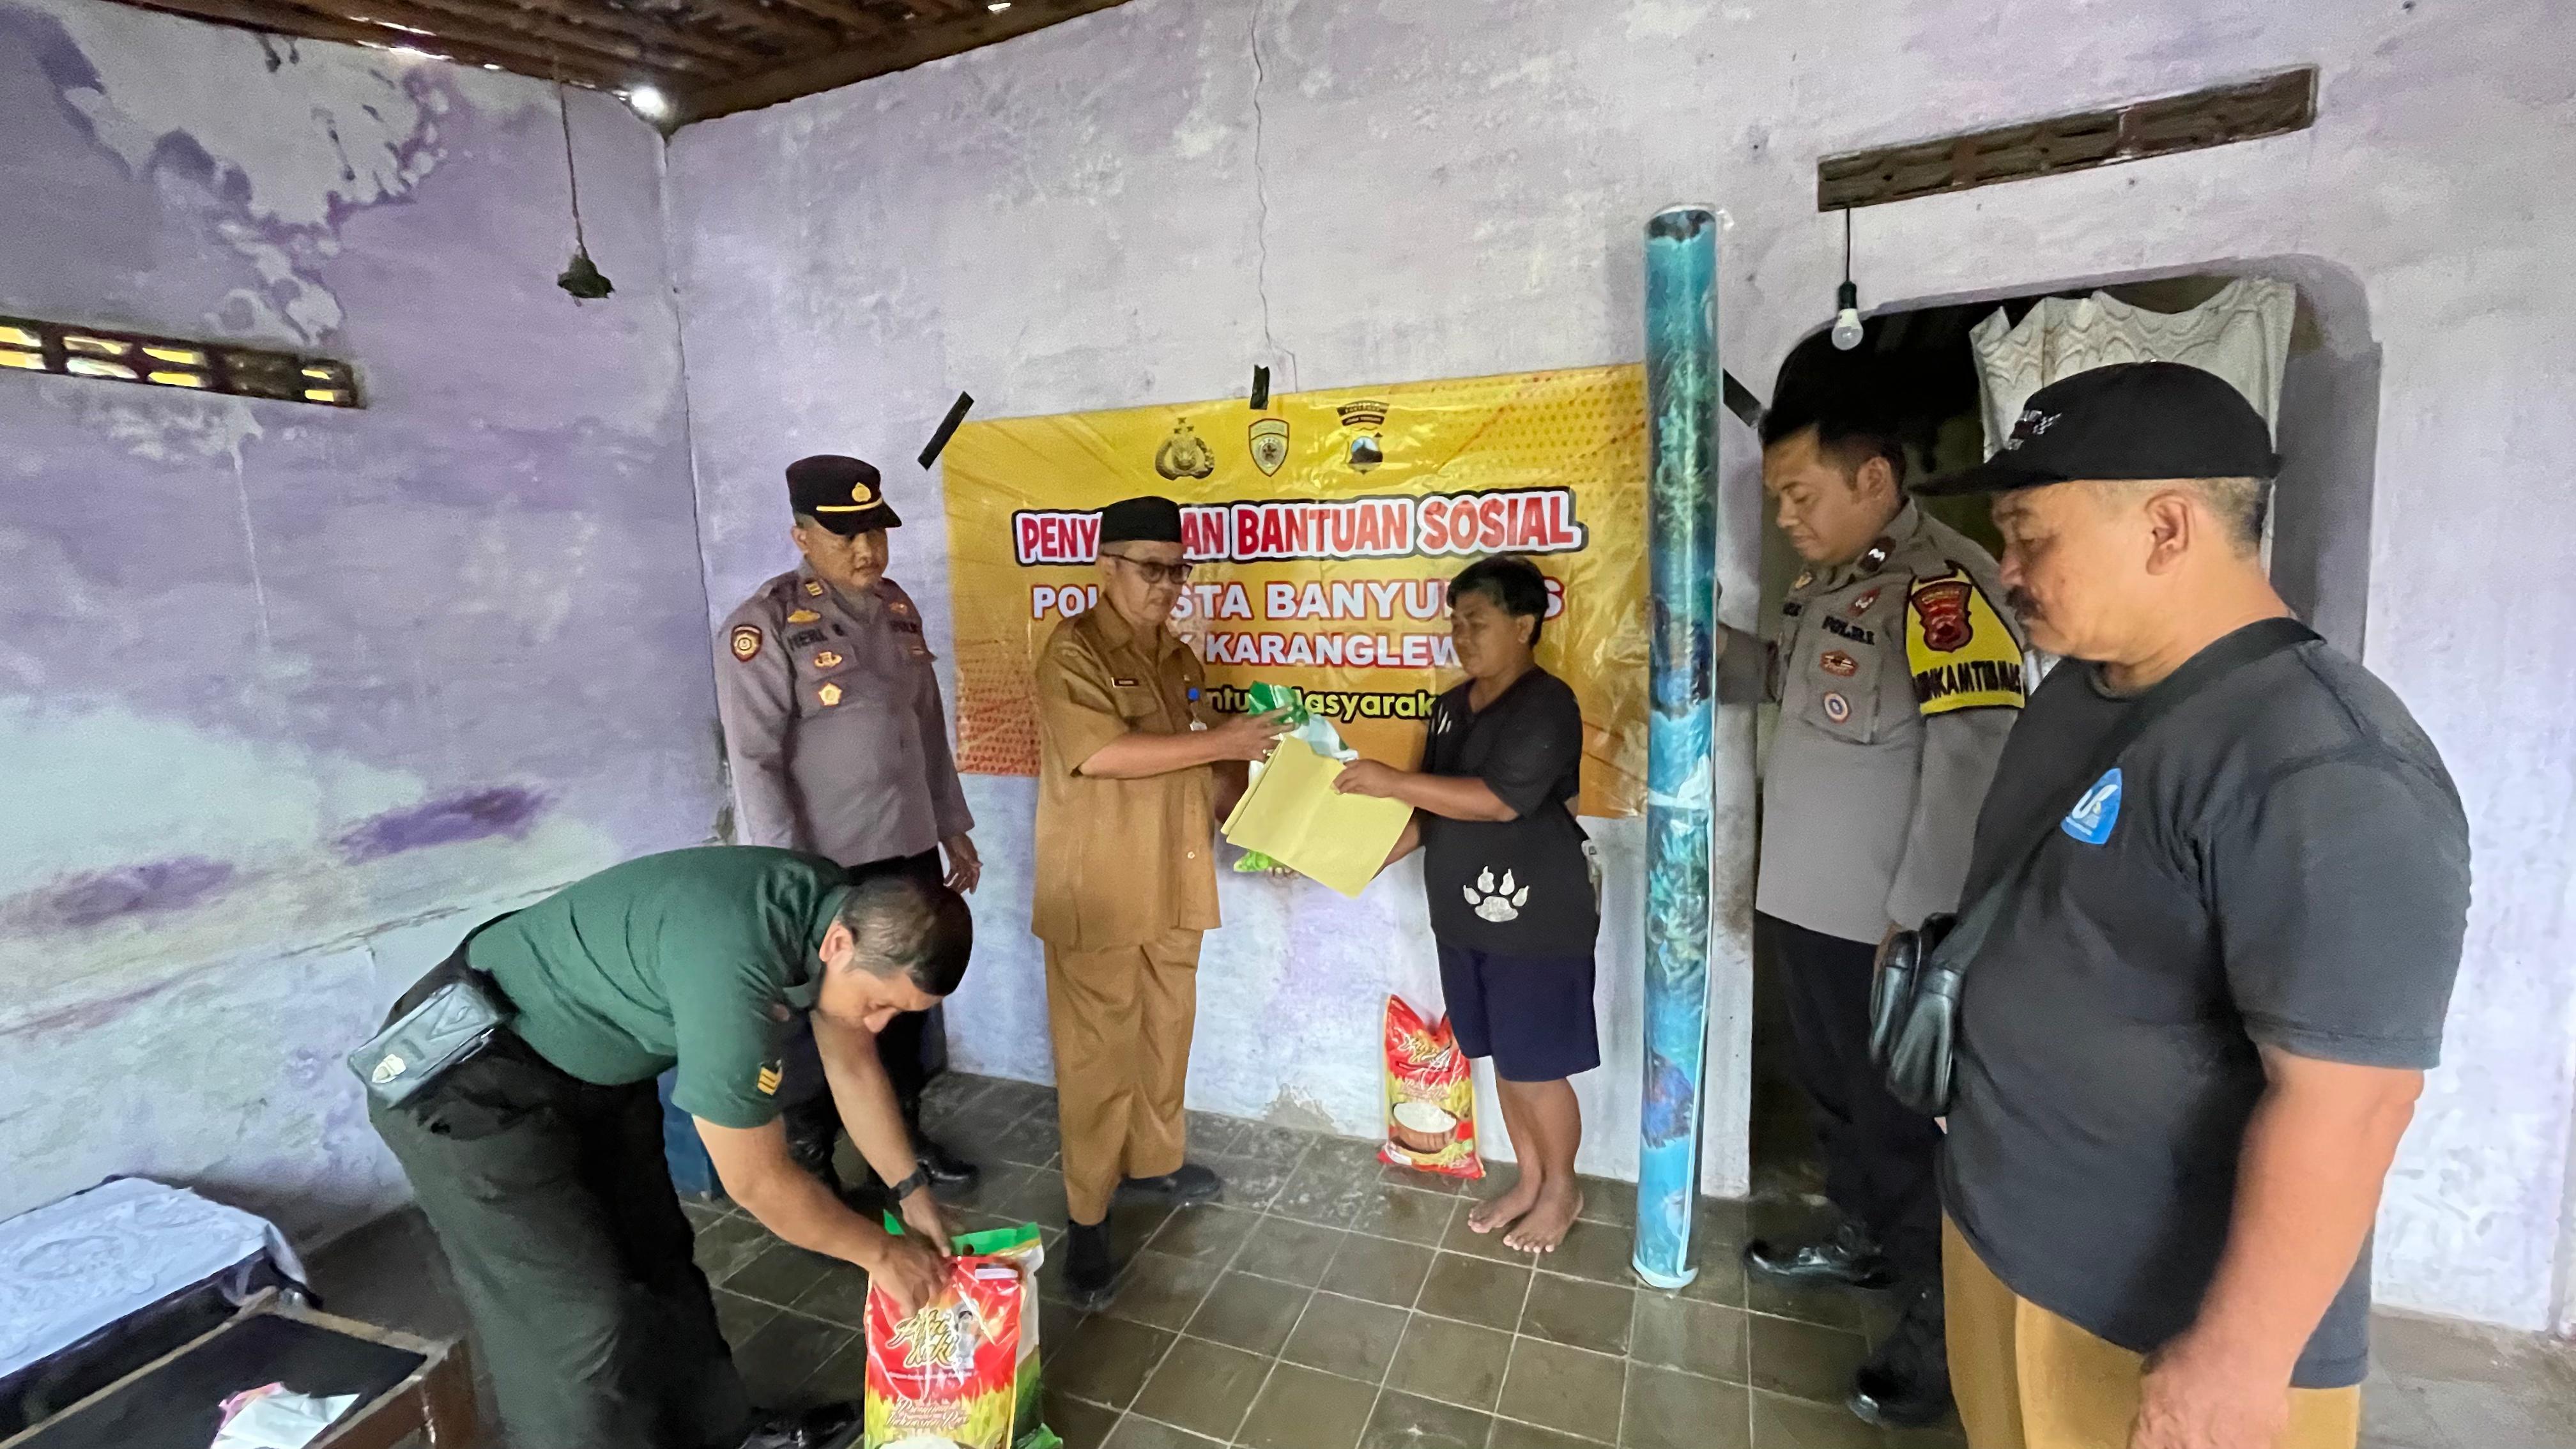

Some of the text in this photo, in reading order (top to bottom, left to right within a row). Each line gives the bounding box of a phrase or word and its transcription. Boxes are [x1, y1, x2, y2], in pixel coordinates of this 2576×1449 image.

[1022, 496, 1574, 558] PENYAN BANTUAN SOSIAL
[1032, 579, 1563, 618] POSTA BANYUS
[1206, 634, 1463, 665] KARANGLEW
[1206, 687, 1436, 721] ntu asyarak
